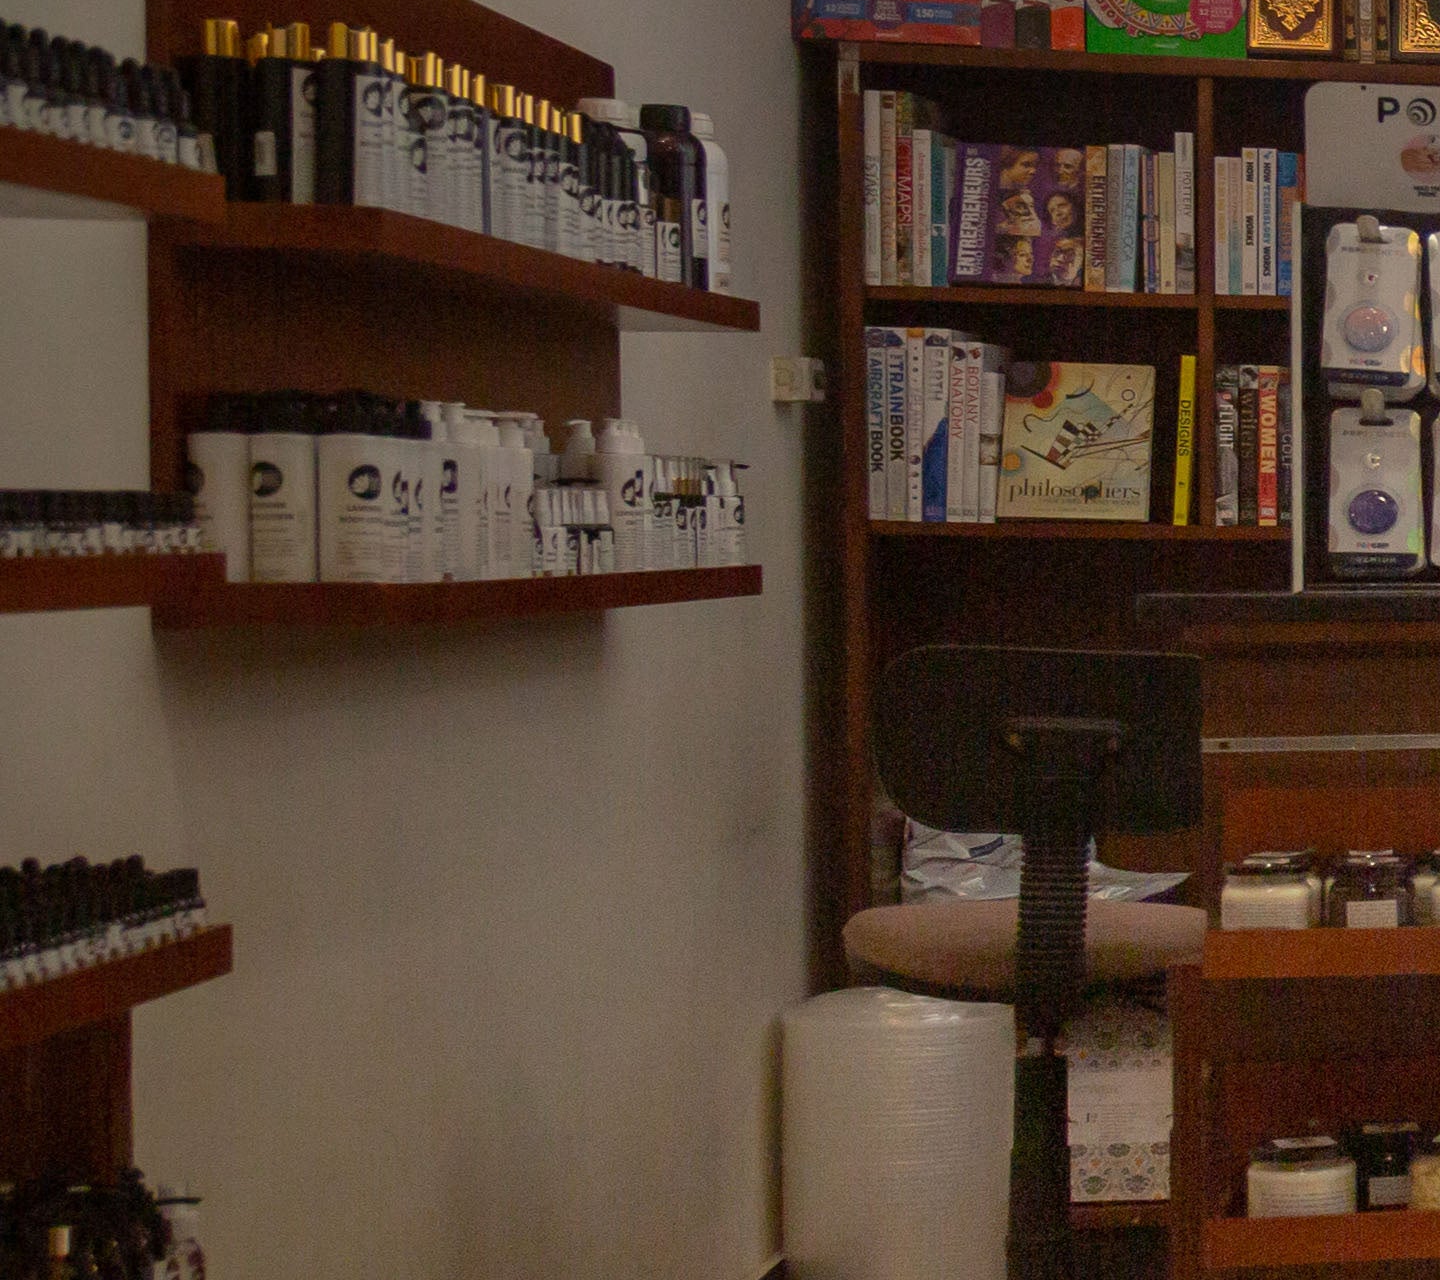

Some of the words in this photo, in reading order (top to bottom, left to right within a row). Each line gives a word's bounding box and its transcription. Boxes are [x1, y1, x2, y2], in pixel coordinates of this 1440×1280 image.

[1182, 171, 1192, 217] POTTERY
[1246, 162, 1254, 182] HOW
[957, 158, 983, 276] ENTREPRENEURS
[1091, 175, 1105, 268] ENTREPRENEURS
[1246, 216, 1254, 246] WORKS
[951, 366, 963, 439] ANATOMY
[967, 367, 980, 424] BOTANY
[1178, 399, 1191, 456] DESIGNS
[1219, 403, 1235, 449] FLIGHT
[1261, 395, 1275, 474] WOMEN
